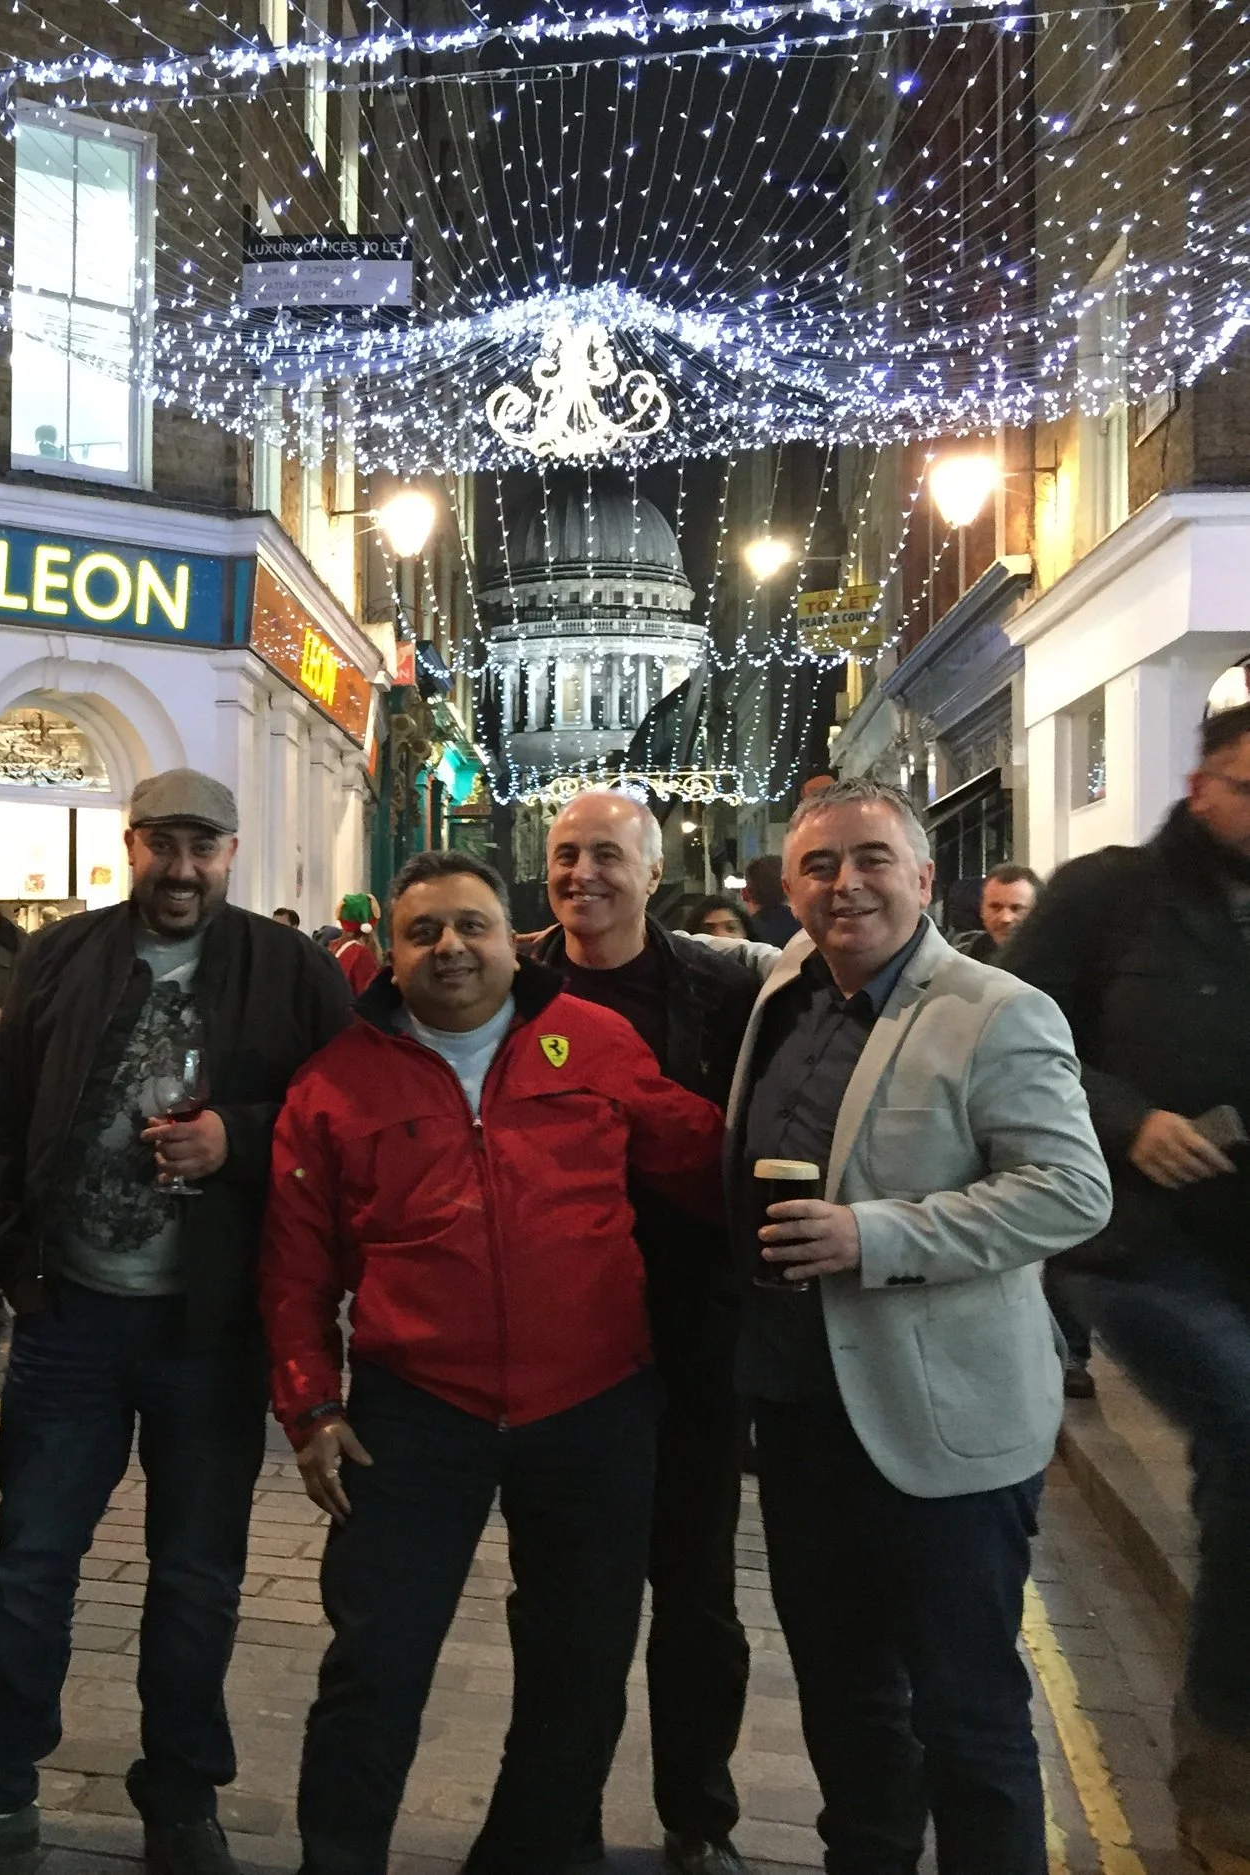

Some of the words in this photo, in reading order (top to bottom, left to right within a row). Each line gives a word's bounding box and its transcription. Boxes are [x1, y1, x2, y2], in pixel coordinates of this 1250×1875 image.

[247, 242, 300, 256] LUXURY
[303, 240, 358, 254] OFFICES
[361, 242, 380, 254] TO
[382, 241, 406, 254] LET
[260, 281, 299, 292] ATLING
[805, 600, 830, 615] TO
[837, 596, 872, 611] LET
[831, 614, 839, 624] &
[300, 627, 338, 706] LEON
